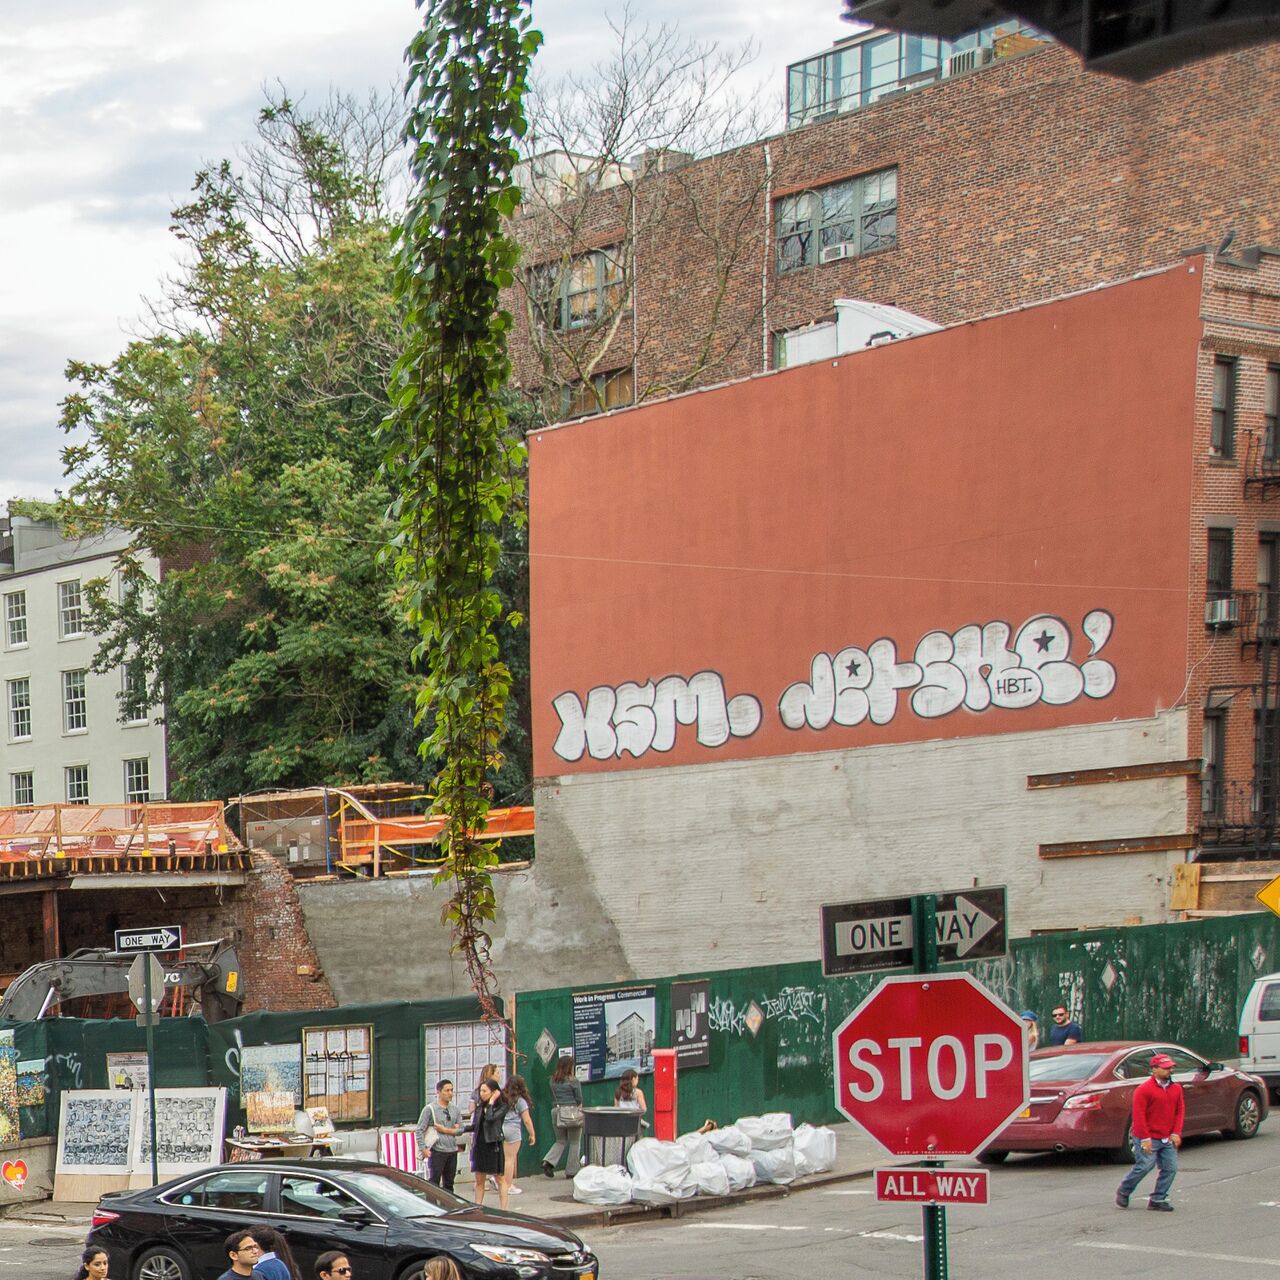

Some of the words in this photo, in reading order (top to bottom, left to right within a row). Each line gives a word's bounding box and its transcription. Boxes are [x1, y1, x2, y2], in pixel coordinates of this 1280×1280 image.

[125, 937, 143, 946] ONE
[151, 935, 170, 945] WAY
[850, 920, 902, 951] ONE
[617, 990, 647, 999] Commercial
[848, 1033, 1013, 1102] STOP
[884, 1175, 925, 1196] ALL
[936, 1177, 979, 1197] WAY
